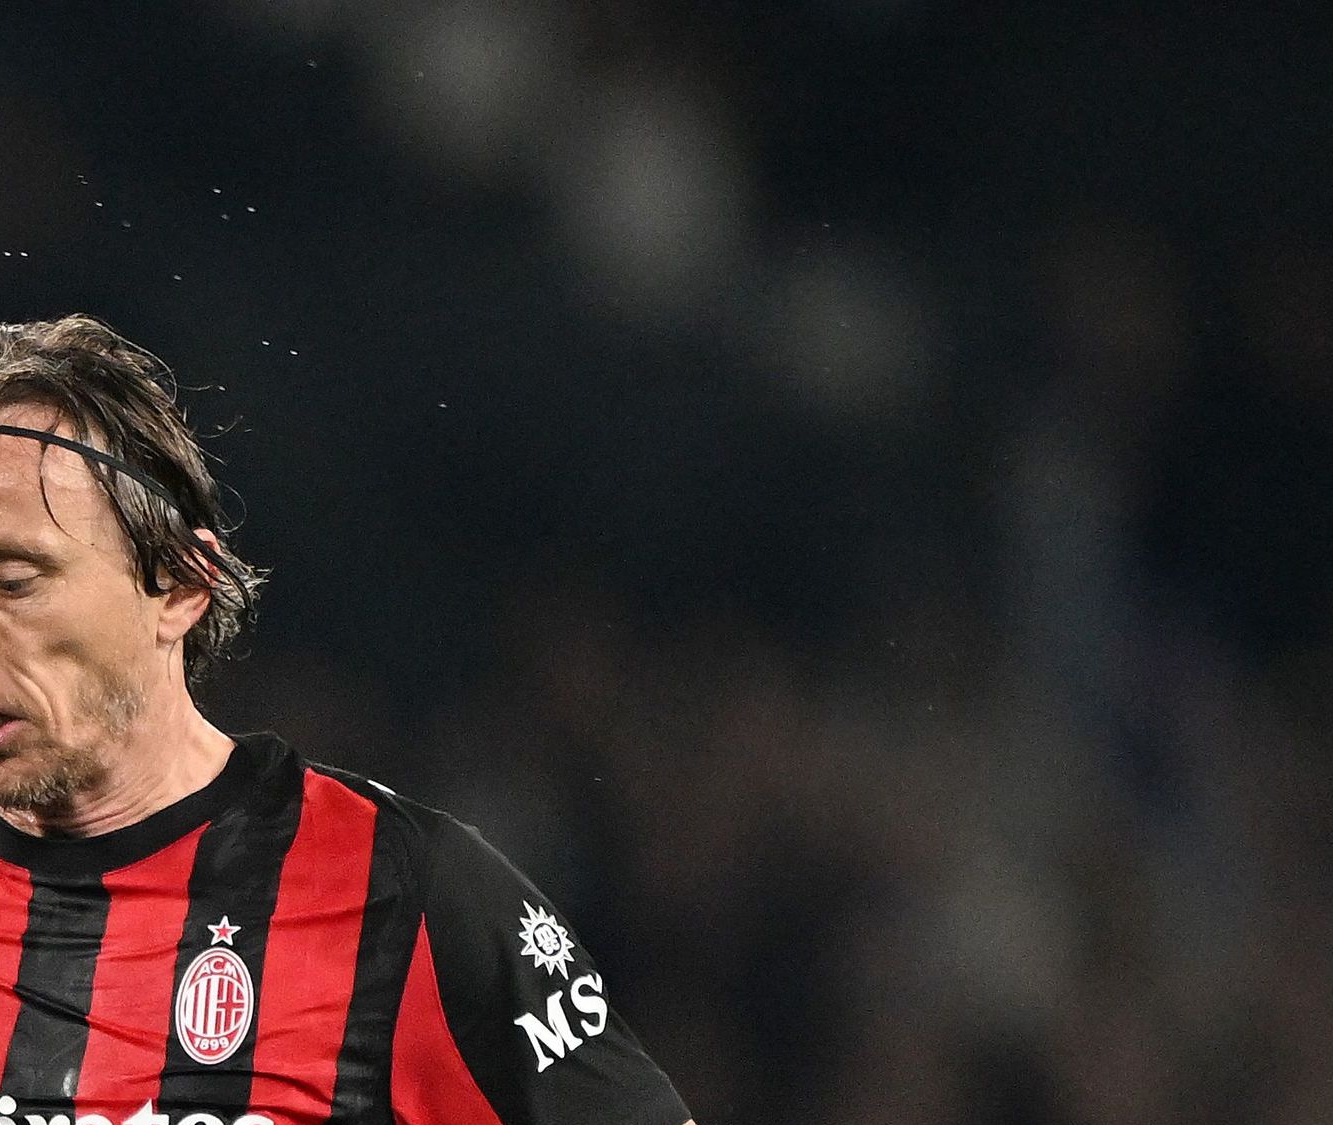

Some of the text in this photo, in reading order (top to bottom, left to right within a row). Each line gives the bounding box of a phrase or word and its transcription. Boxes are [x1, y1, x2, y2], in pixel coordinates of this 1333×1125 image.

[194, 957, 239, 982] ACM
[513, 971, 608, 1074] MS
[193, 1036, 230, 1051] 1899
